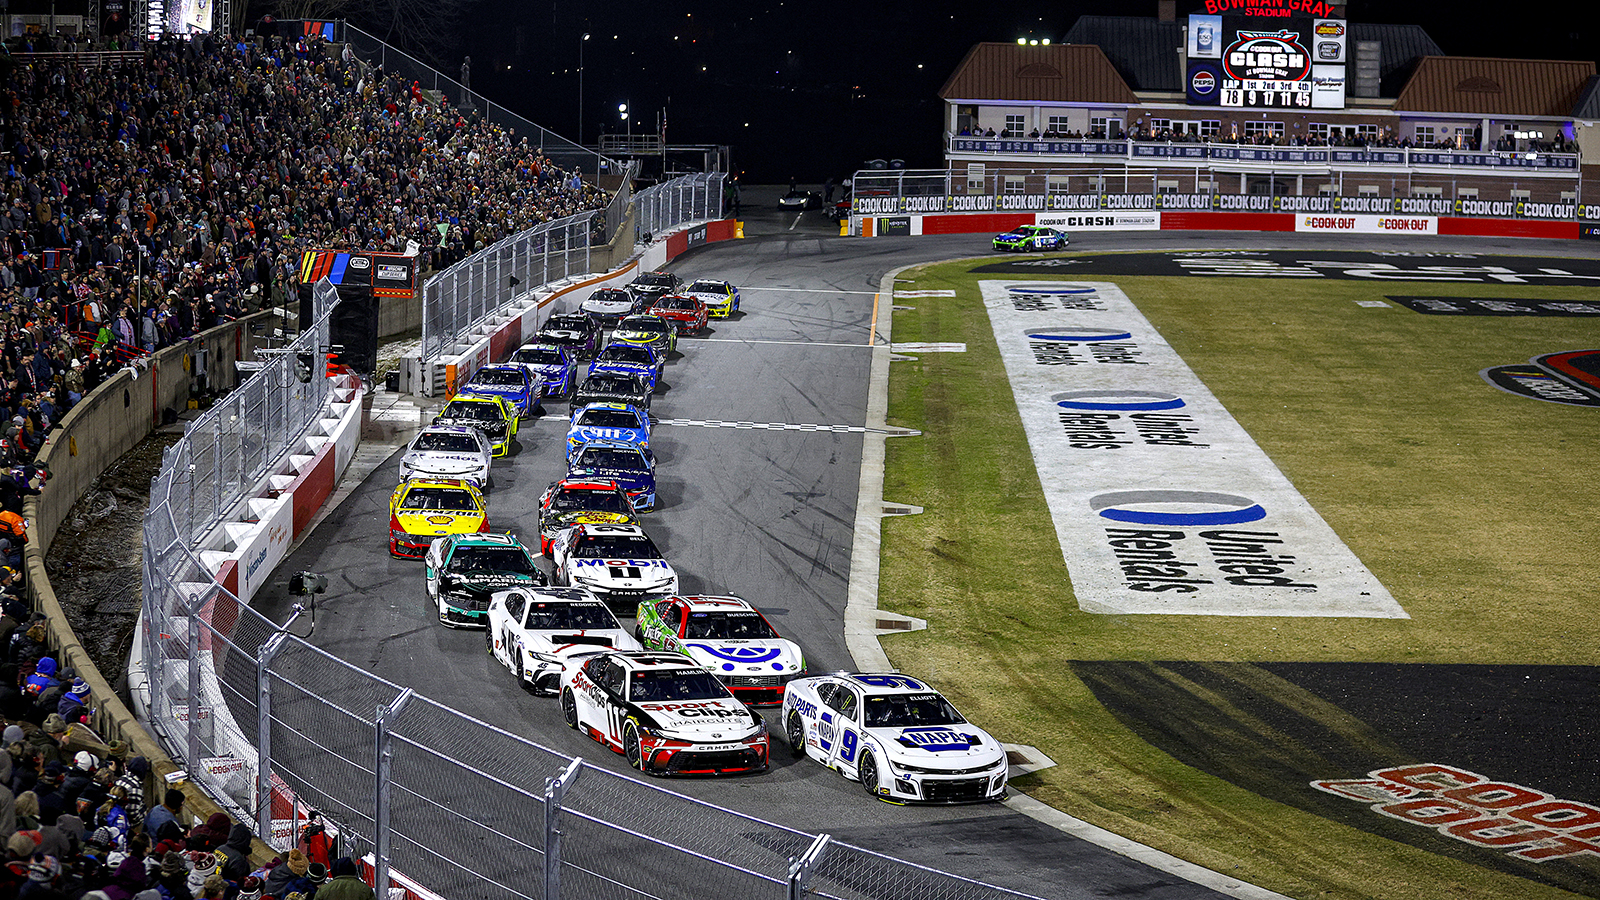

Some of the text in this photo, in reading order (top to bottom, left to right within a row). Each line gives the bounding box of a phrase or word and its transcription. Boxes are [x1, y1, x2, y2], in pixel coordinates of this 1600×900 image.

[1205, 0, 1335, 19] BOWMAN GRAY
[1245, 8, 1291, 17] STADIUM
[1230, 52, 1303, 68] CLASH
[1223, 79, 1309, 91] LAP 1st 2nd 3rd 4th
[1226, 90, 1310, 106] 78 9 17 11 45
[859, 197, 898, 213] COOK OUT
[906, 196, 945, 211] COOK OUT
[953, 196, 993, 210] COOK OUT
[1002, 195, 1045, 209] COOK OUT
[1053, 195, 1097, 209] COOK OUT
[1107, 194, 1153, 208] COOK OUT
[1162, 194, 1210, 208] COOK OUT
[1220, 195, 1270, 210] COOK OUT
[1281, 196, 1330, 211] COOK OUT
[1341, 198, 1391, 212] COOK OUT
[1401, 198, 1451, 214] COOK OUT
[1462, 200, 1513, 216] COOK OUT
[1524, 203, 1575, 218] COOK OUT
[1068, 217, 1114, 226] CLASH
[1312, 217, 1356, 229] COOK OUT
[1385, 219, 1429, 230] COOK OUT
[1034, 236, 1041, 247] 8
[1058, 412, 1133, 449] Rentals
[1128, 413, 1210, 448] United
[575, 559, 668, 569] Mobil
[1105, 528, 1214, 594] Rentals
[1197, 530, 1318, 589] United
[571, 671, 607, 709] Sport Clips
[909, 694, 938, 702] ELLIOTT
[641, 701, 726, 712] Sport
[678, 707, 750, 718] Clips
[797, 697, 818, 721] PARTS
[606, 701, 623, 744] 11
[673, 718, 742, 728] HAIRCUTS
[818, 720, 834, 743] NAPA
[908, 731, 965, 744] NAPA
[653, 738, 667, 747] 11
[841, 727, 859, 763] 9
[902, 773, 911, 781] 9
